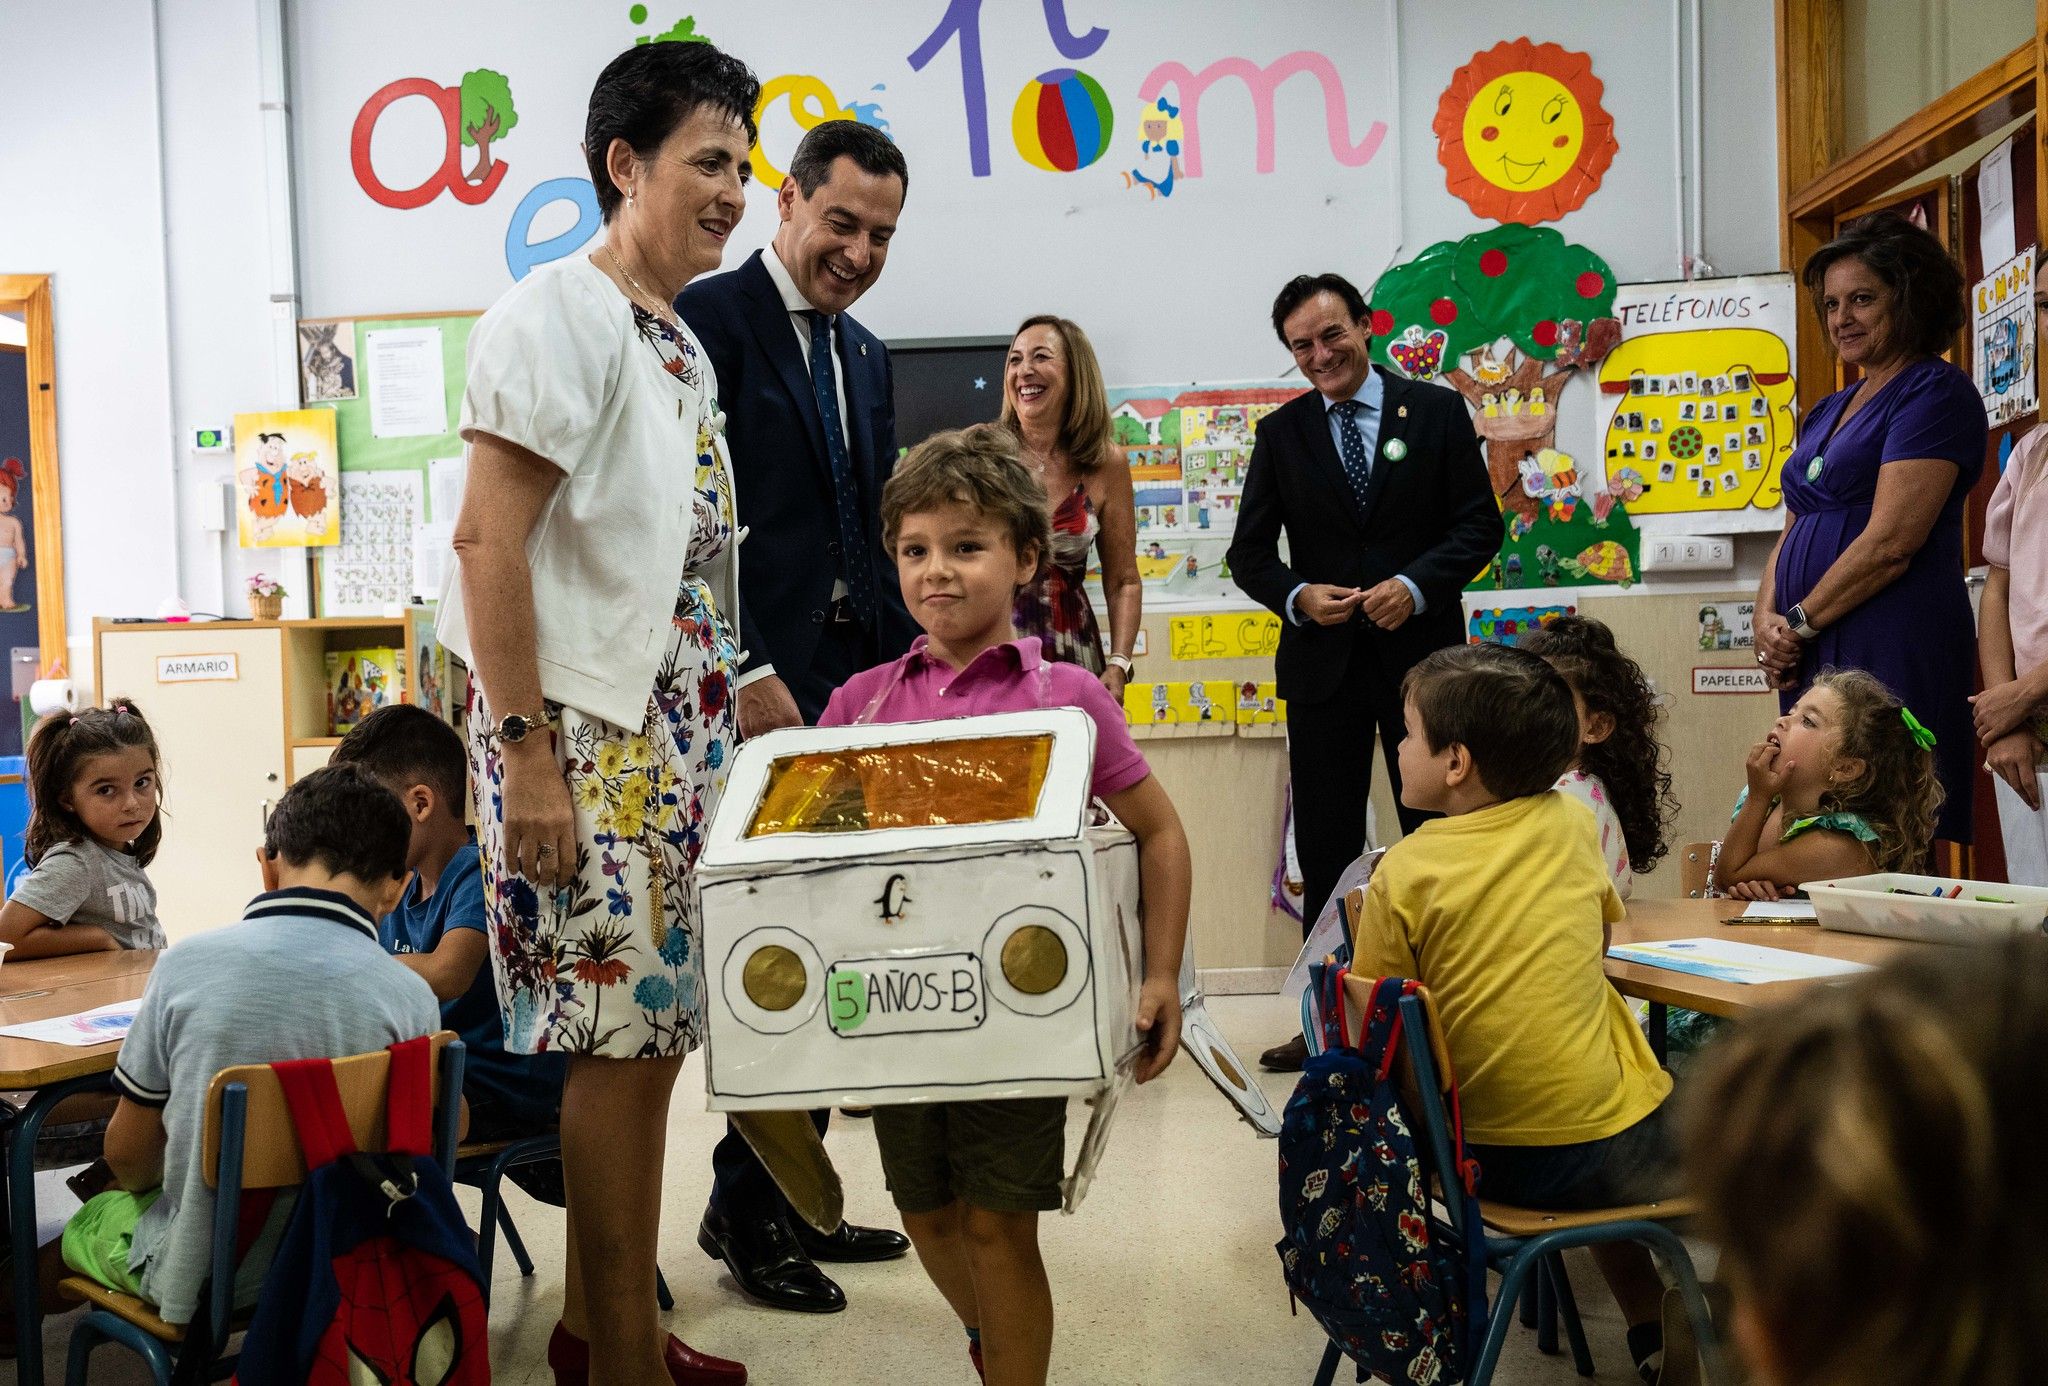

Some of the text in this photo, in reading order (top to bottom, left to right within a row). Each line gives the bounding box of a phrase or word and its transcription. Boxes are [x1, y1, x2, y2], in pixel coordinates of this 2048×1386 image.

[165, 660, 229, 675] ARMARIO
[1700, 674, 1763, 687] PAPELERA
[836, 979, 859, 1021] 5
